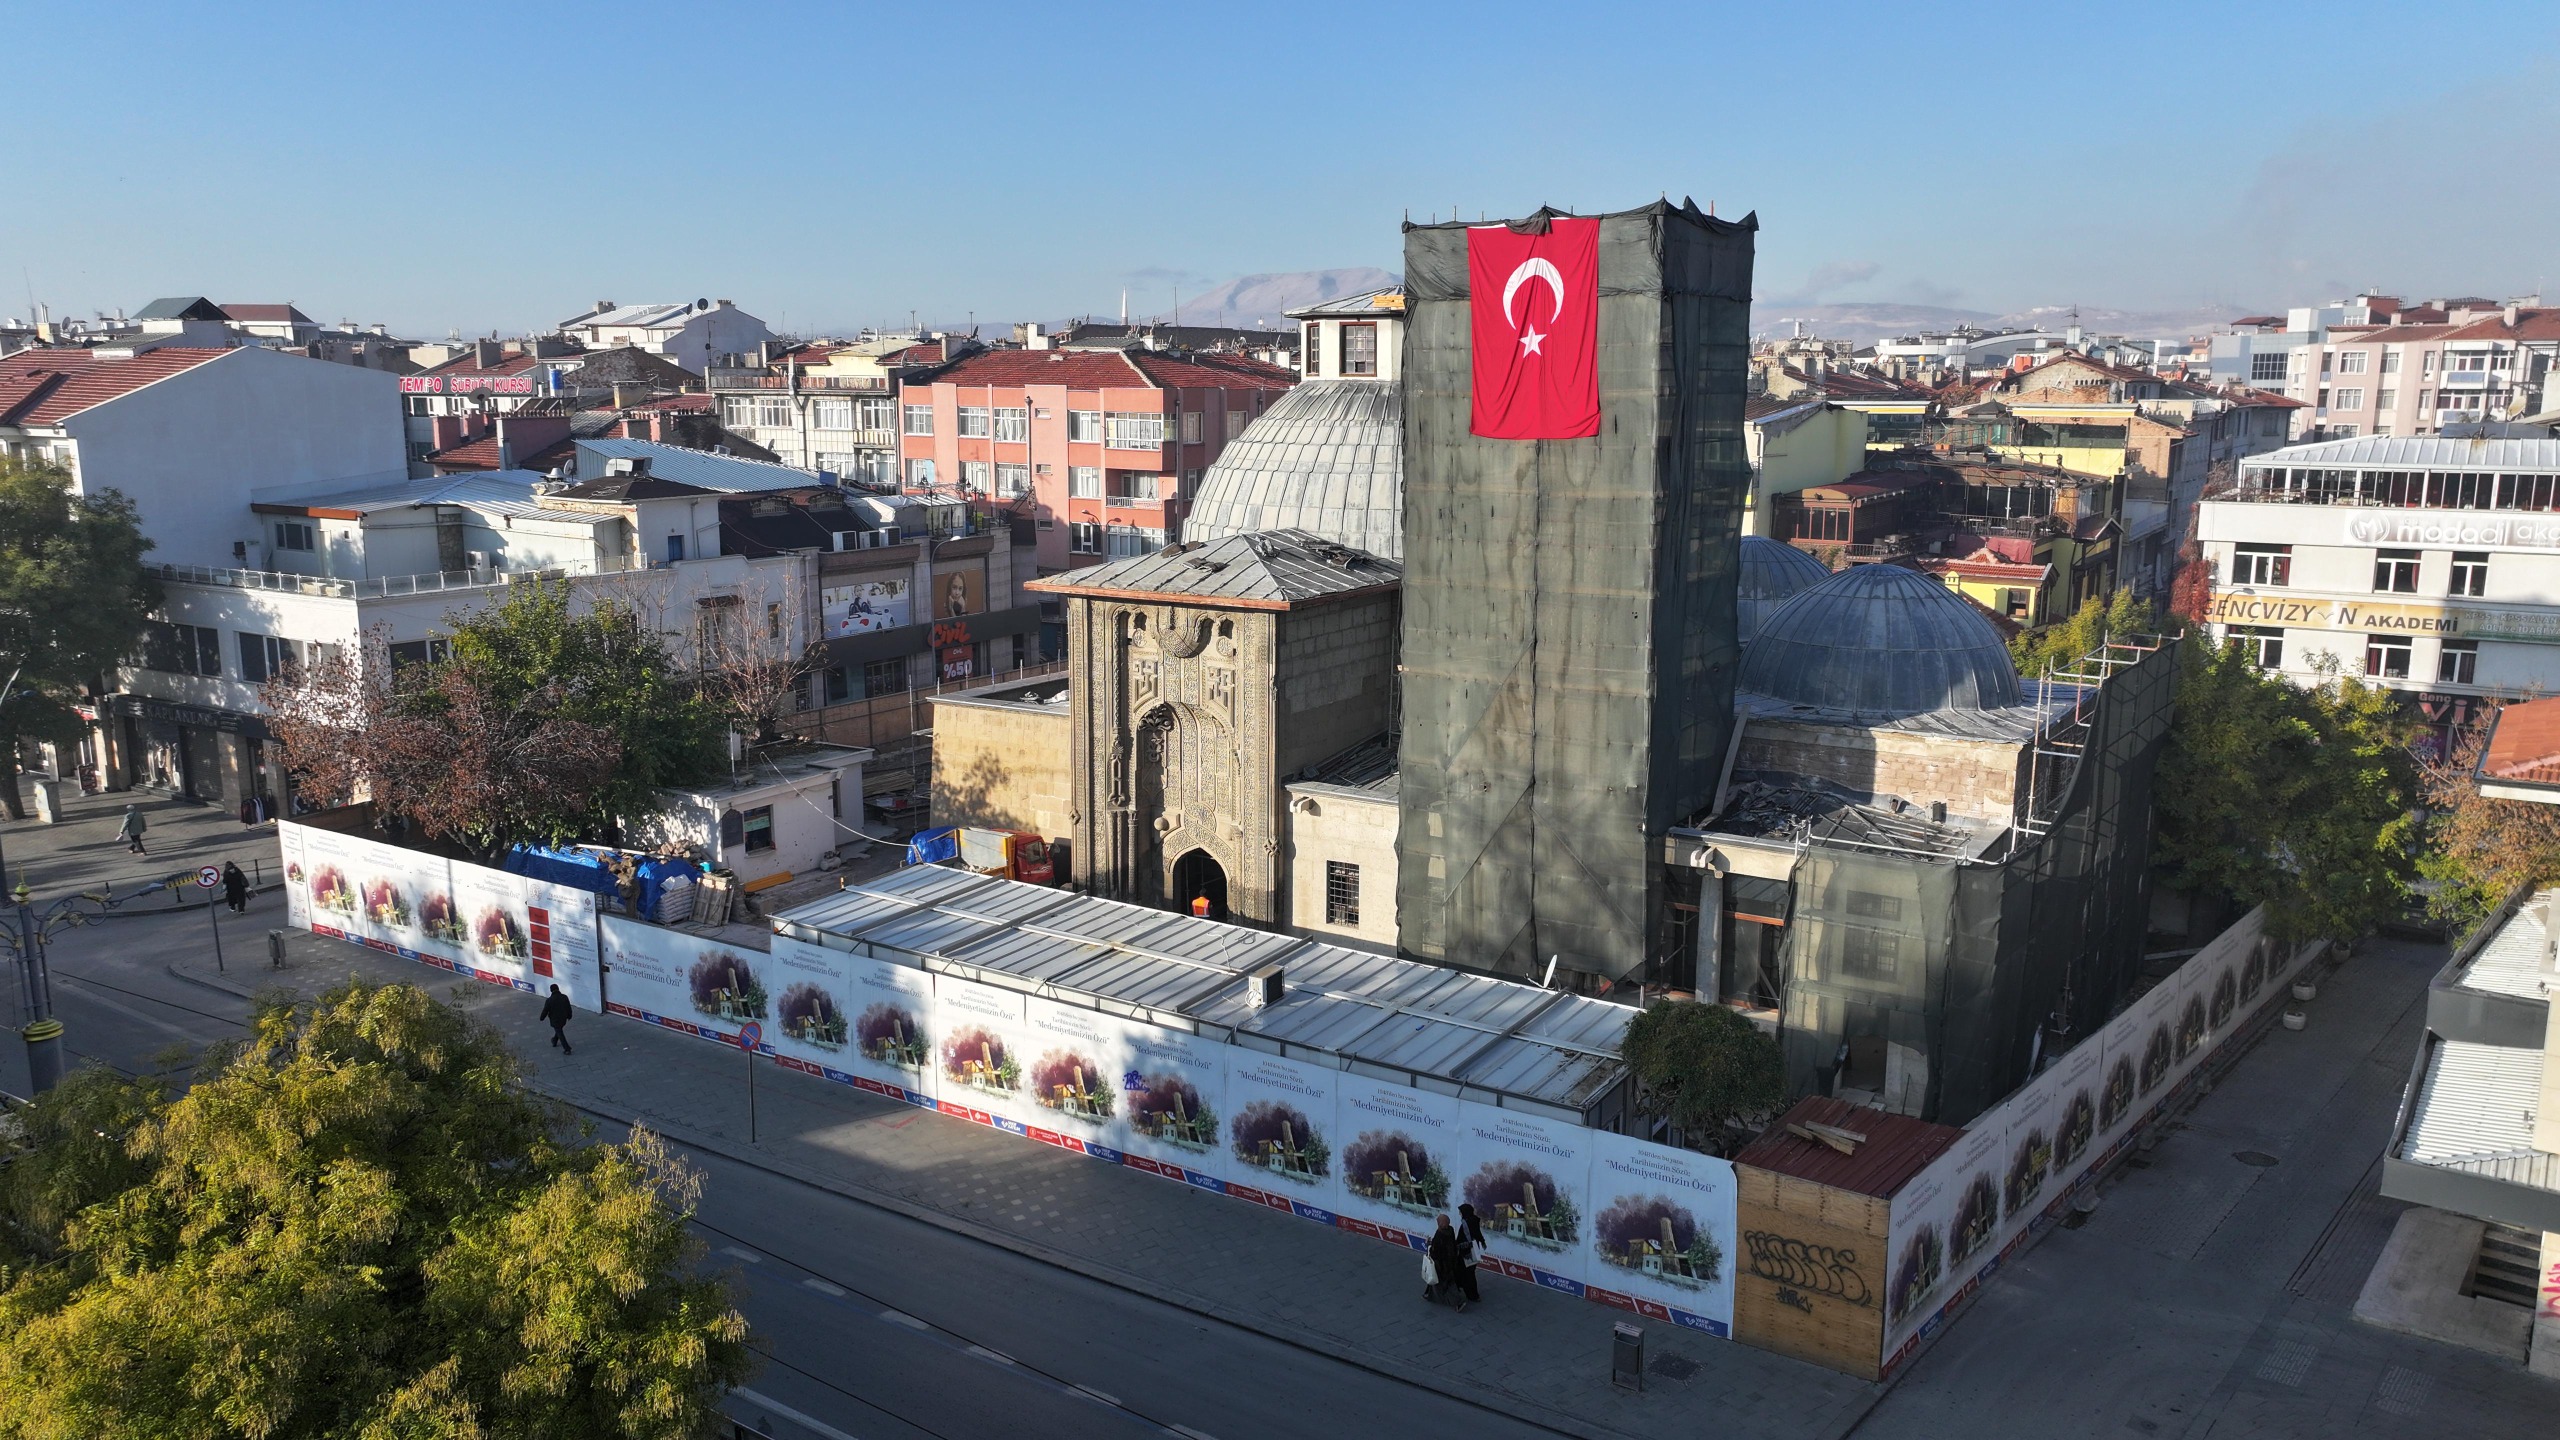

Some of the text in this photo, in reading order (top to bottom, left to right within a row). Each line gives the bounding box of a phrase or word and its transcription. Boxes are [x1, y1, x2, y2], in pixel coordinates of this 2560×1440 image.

[494, 377, 532, 393] KURSU
[2364, 614, 2459, 633] AKADEMİ
[1350, 1098, 1422, 1123] “Medeniyetimizin
[1471, 1127, 1550, 1154] “Medeniyetimizin
[1605, 1159, 1690, 1188] “Medeniyetimizin
